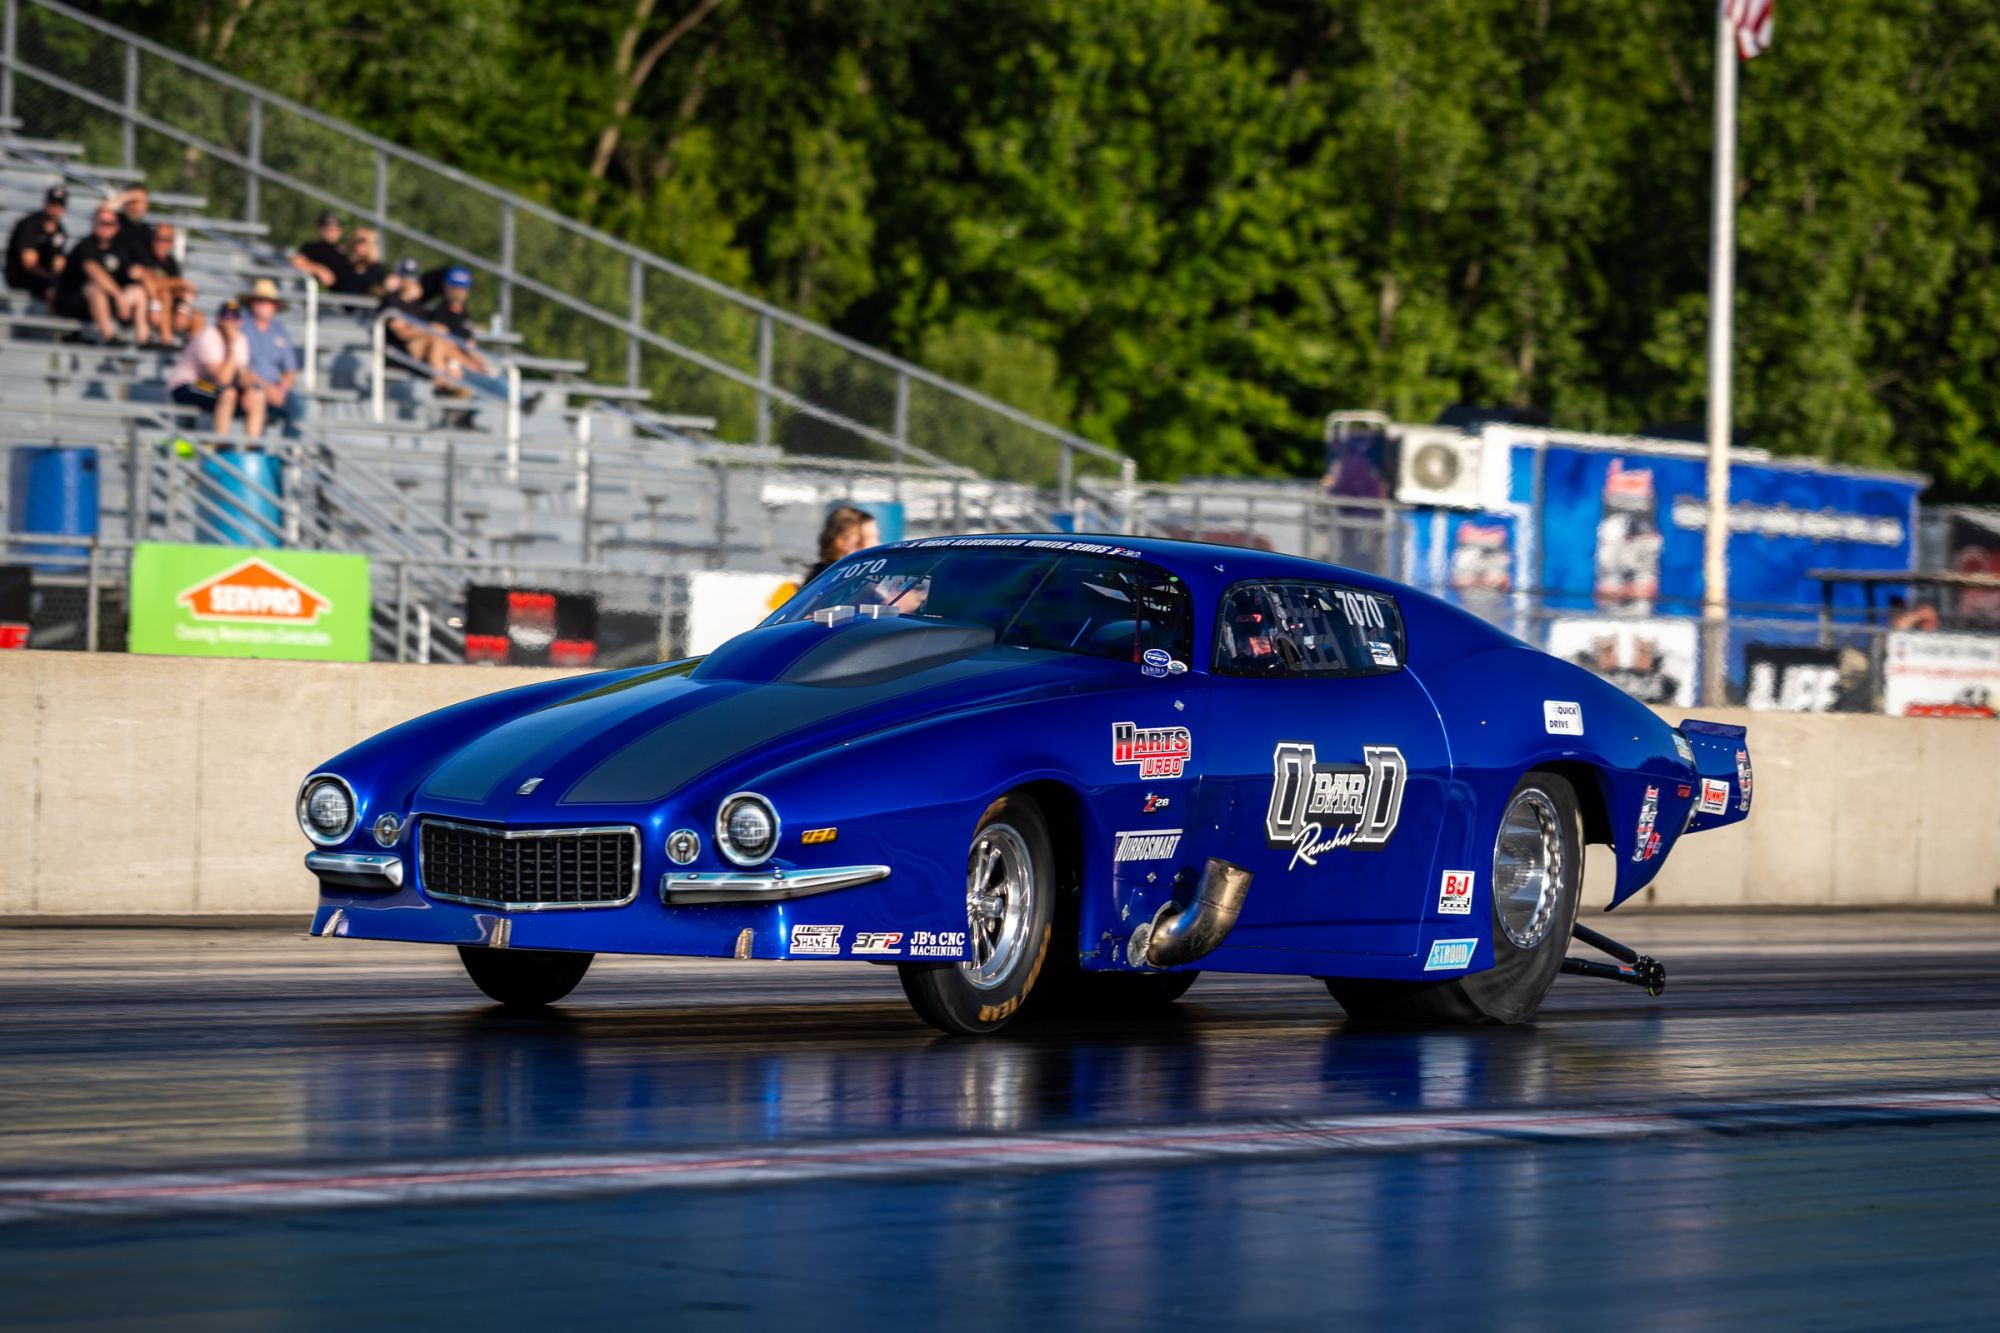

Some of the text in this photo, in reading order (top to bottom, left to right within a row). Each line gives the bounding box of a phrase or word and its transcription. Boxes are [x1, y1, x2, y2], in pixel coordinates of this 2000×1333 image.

[1023, 540, 1069, 549] WINTER
[1066, 542, 1112, 554] SERIES
[831, 558, 888, 582] 7070
[210, 584, 302, 615] SERVPRO
[1334, 590, 1385, 629] 7070
[1557, 705, 1576, 715] QUICK
[1549, 719, 1569, 729] DRIVE
[1113, 723, 1189, 761] HARTS
[1141, 757, 1182, 776] TURBO
[1353, 746, 1407, 843] D
[1114, 829, 1184, 862] TURBOSMART
[1445, 875, 1470, 896] B&J
[793, 932, 828, 948] SHANE
[910, 931, 965, 946] JB's CNC
[909, 945, 963, 957] MACHINING
[1433, 944, 1468, 965] STROUD
